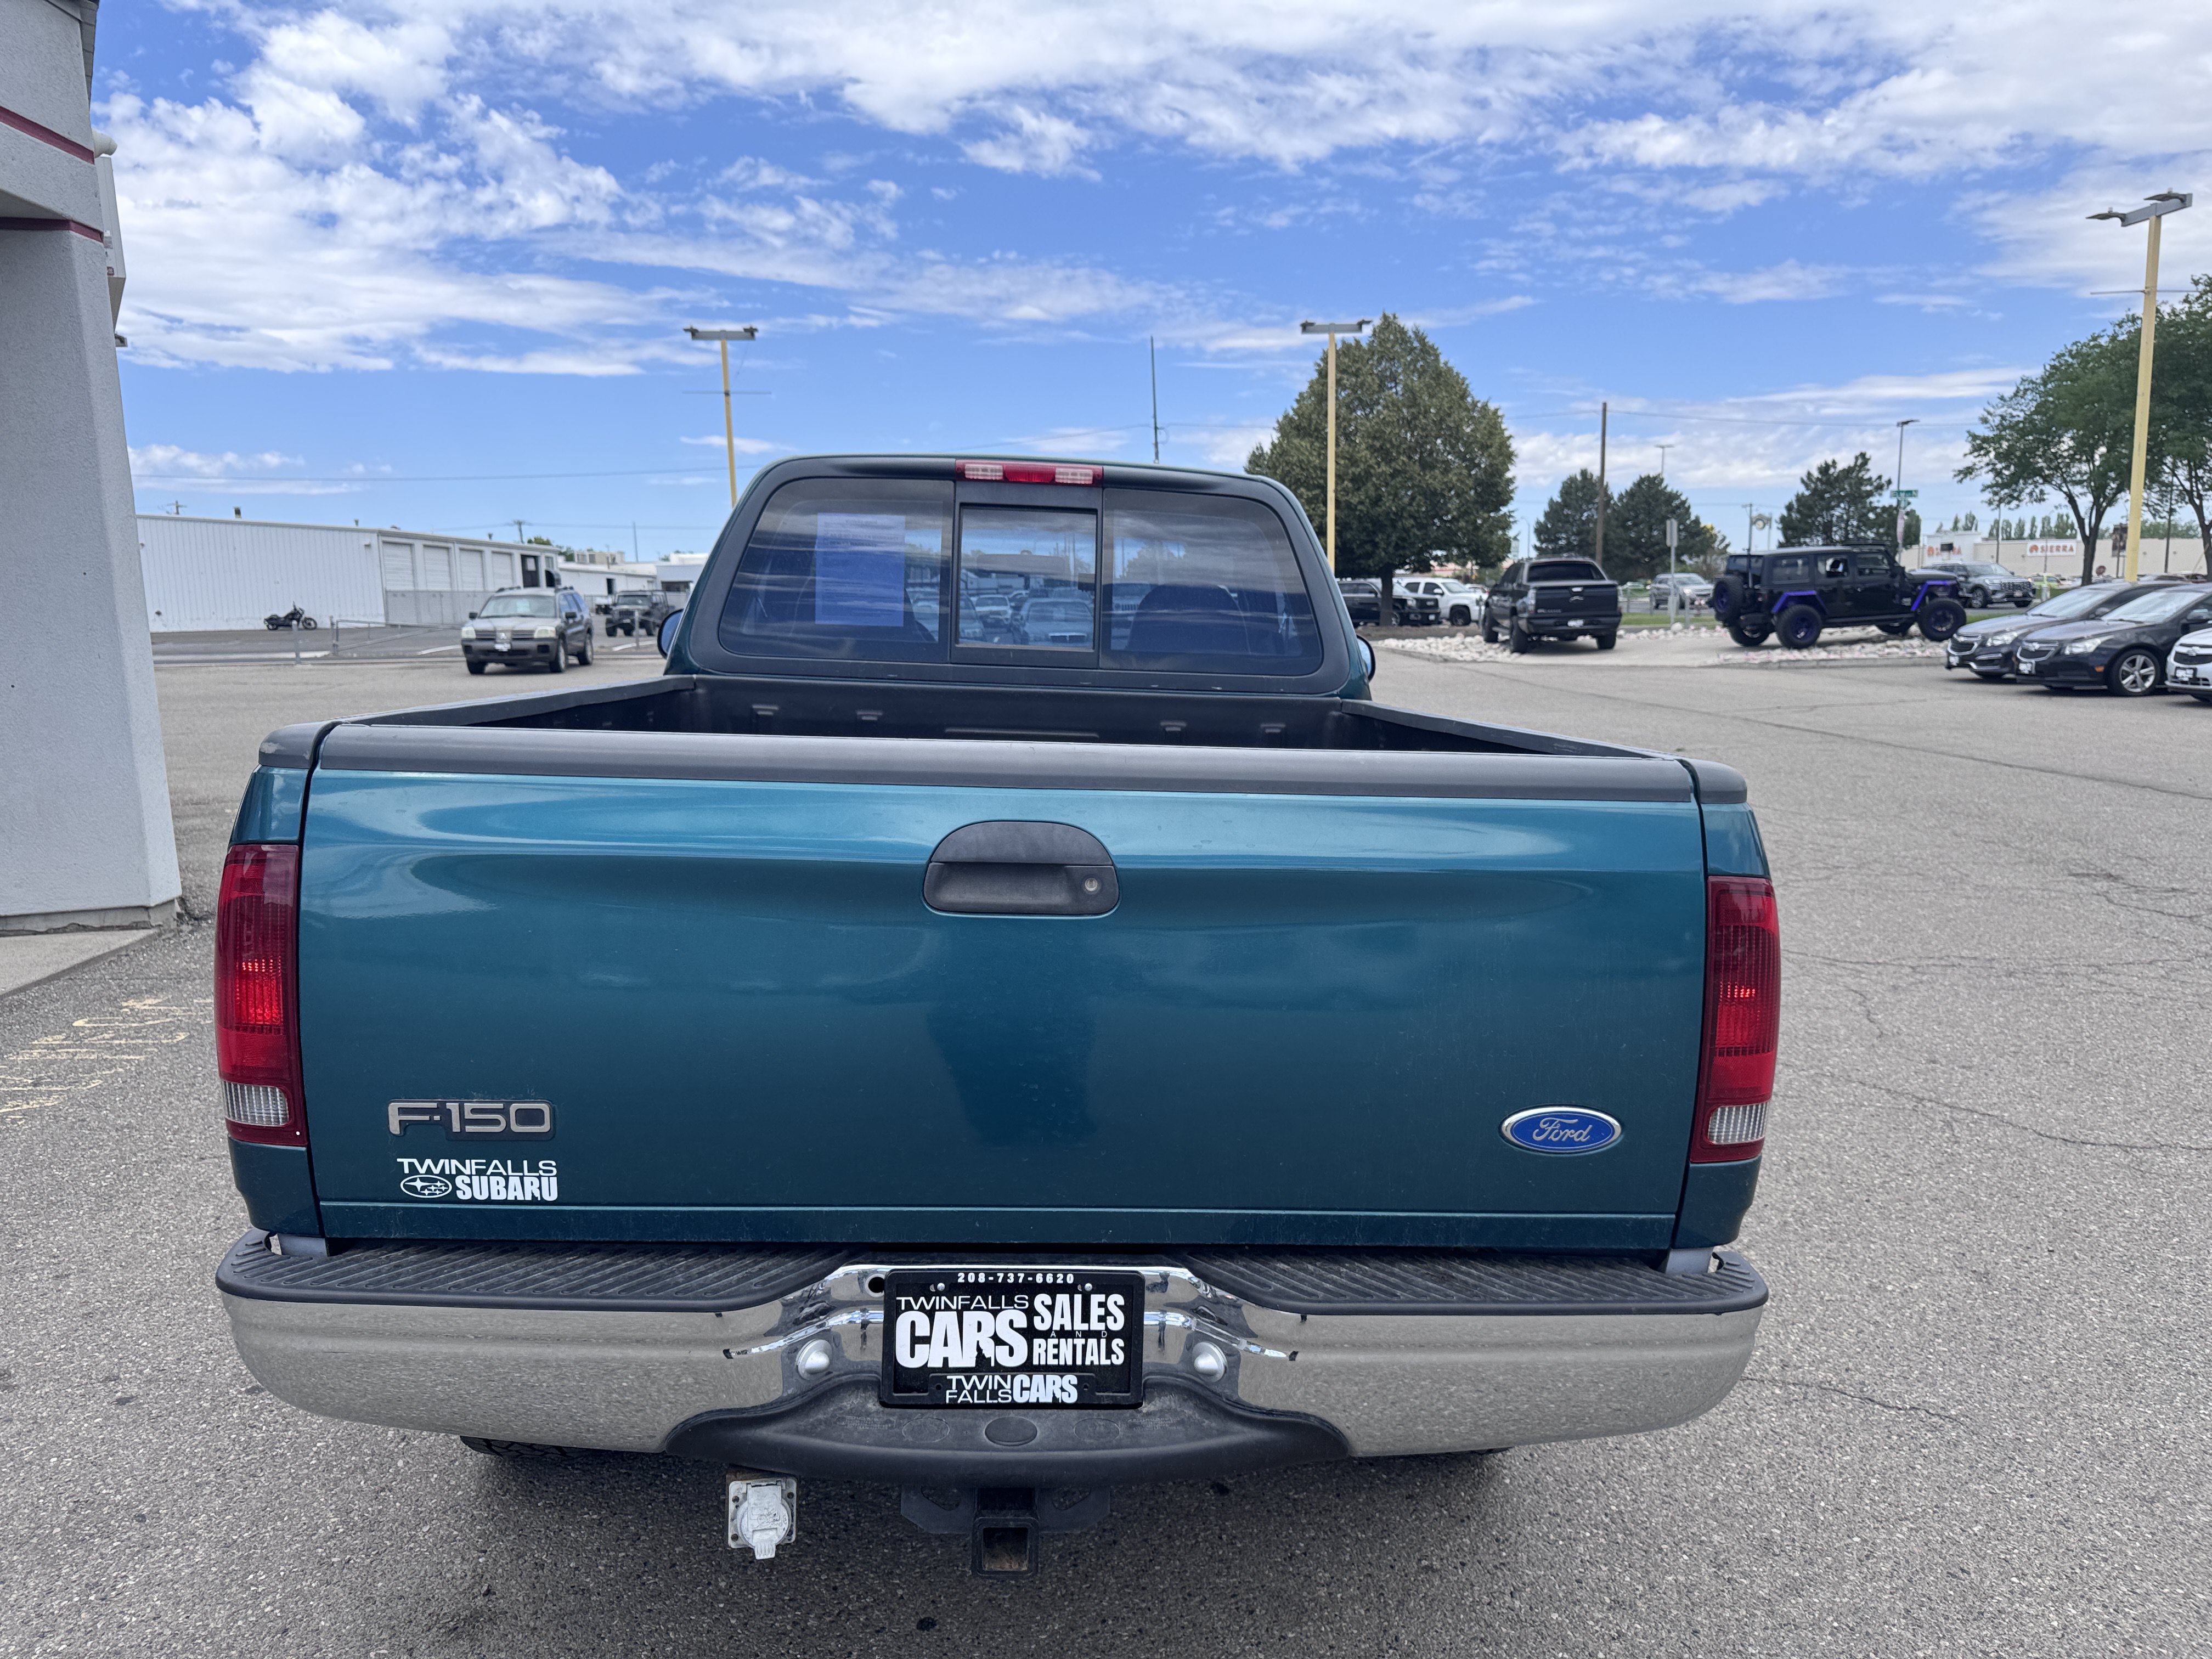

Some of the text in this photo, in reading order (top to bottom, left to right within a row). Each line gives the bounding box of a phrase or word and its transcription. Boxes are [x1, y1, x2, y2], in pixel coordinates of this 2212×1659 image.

[2040, 544, 2074, 553] SERRA
[388, 1103, 551, 1135] F-150
[1532, 1117, 1593, 1142] Ford
[455, 1175, 558, 1201] SUBARU
[957, 1273, 1074, 1284] 208-737-6620
[1034, 1294, 1125, 1331] SALES
[895, 1310, 1028, 1368] CARS
[1033, 1338, 1125, 1366] RENTALS
[946, 1375, 1010, 1390] TWIN
[1013, 1374, 1078, 1403] CARS
[946, 1390, 1013, 1404] FALLS
